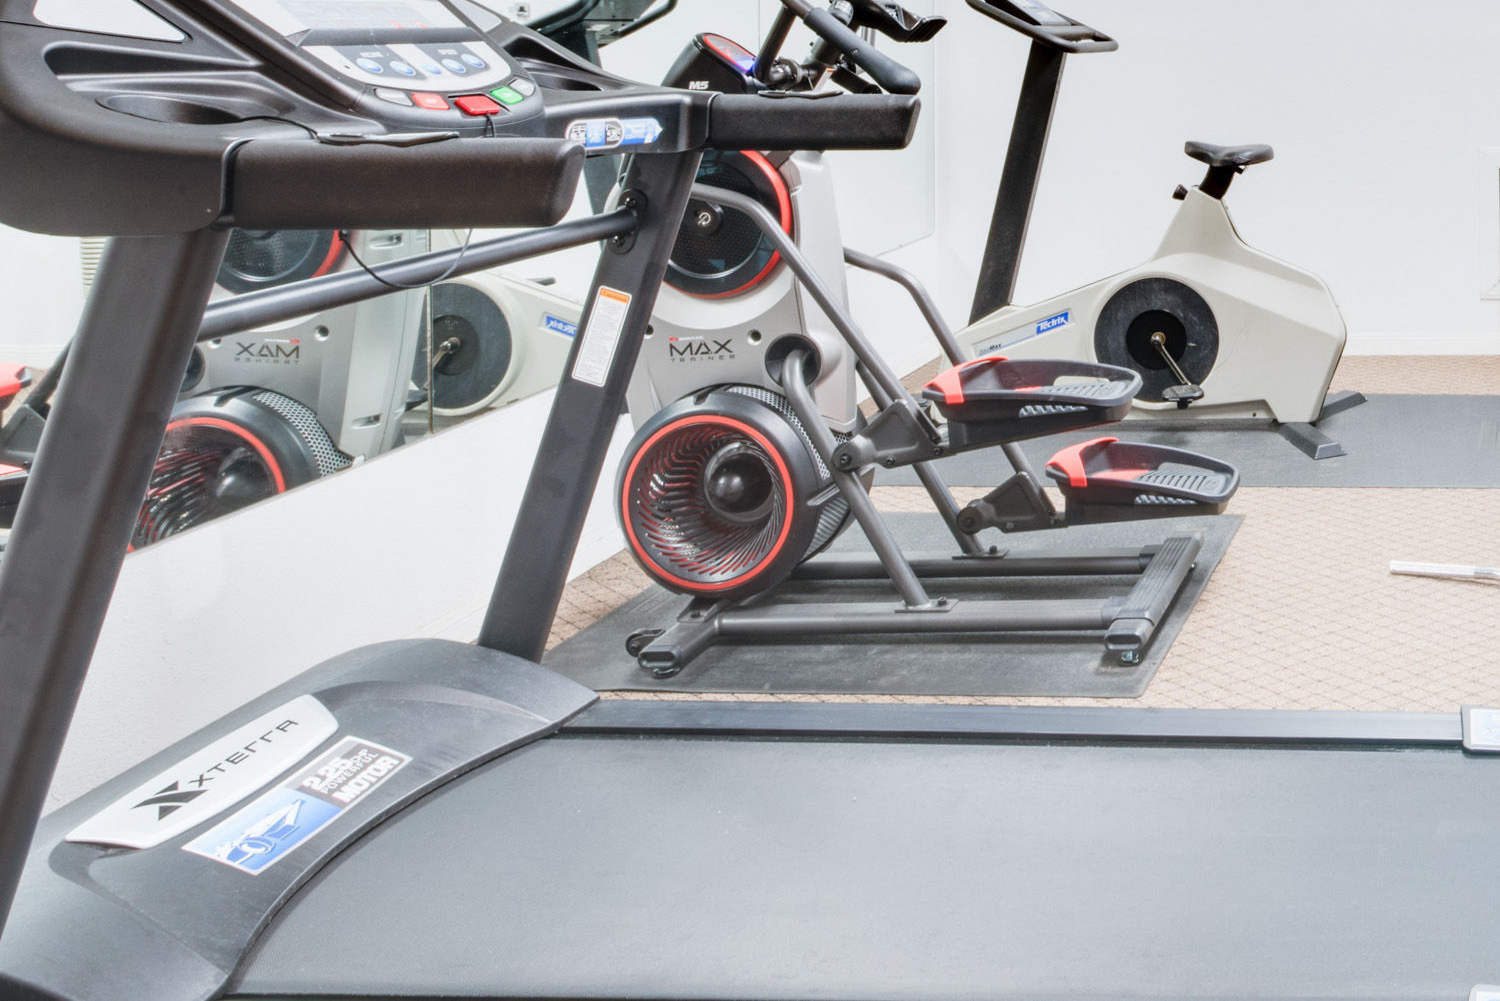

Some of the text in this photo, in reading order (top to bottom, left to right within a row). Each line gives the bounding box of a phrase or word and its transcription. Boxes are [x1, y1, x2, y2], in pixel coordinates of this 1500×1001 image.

[688, 81, 709, 91] M5
[1037, 316, 1068, 331] Tectrix
[669, 339, 733, 357] MAX
[319, 752, 379, 794] POWERFUL
[331, 755, 400, 803] MOTOR
